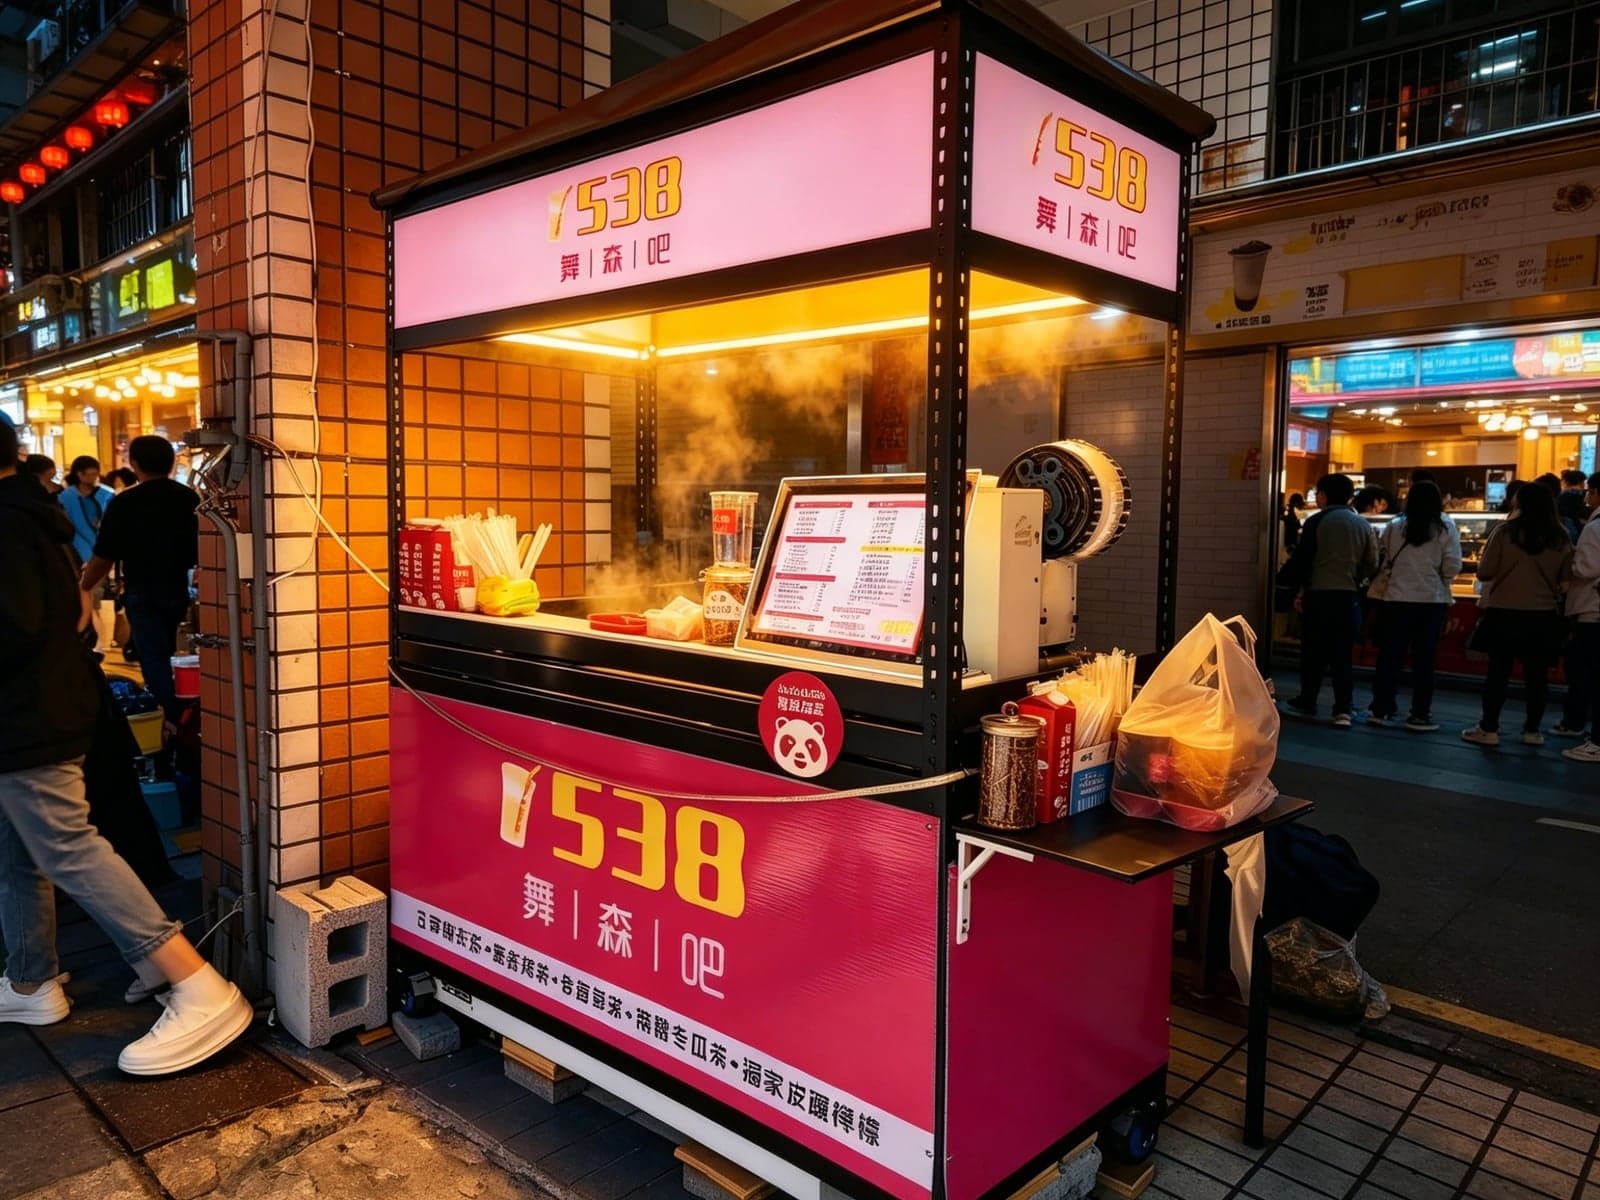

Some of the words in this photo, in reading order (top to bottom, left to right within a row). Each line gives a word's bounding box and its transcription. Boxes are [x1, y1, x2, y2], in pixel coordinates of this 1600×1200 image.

[576, 156, 682, 236] 538
[1055, 117, 1148, 214] 538
[551, 771, 746, 919] 538
